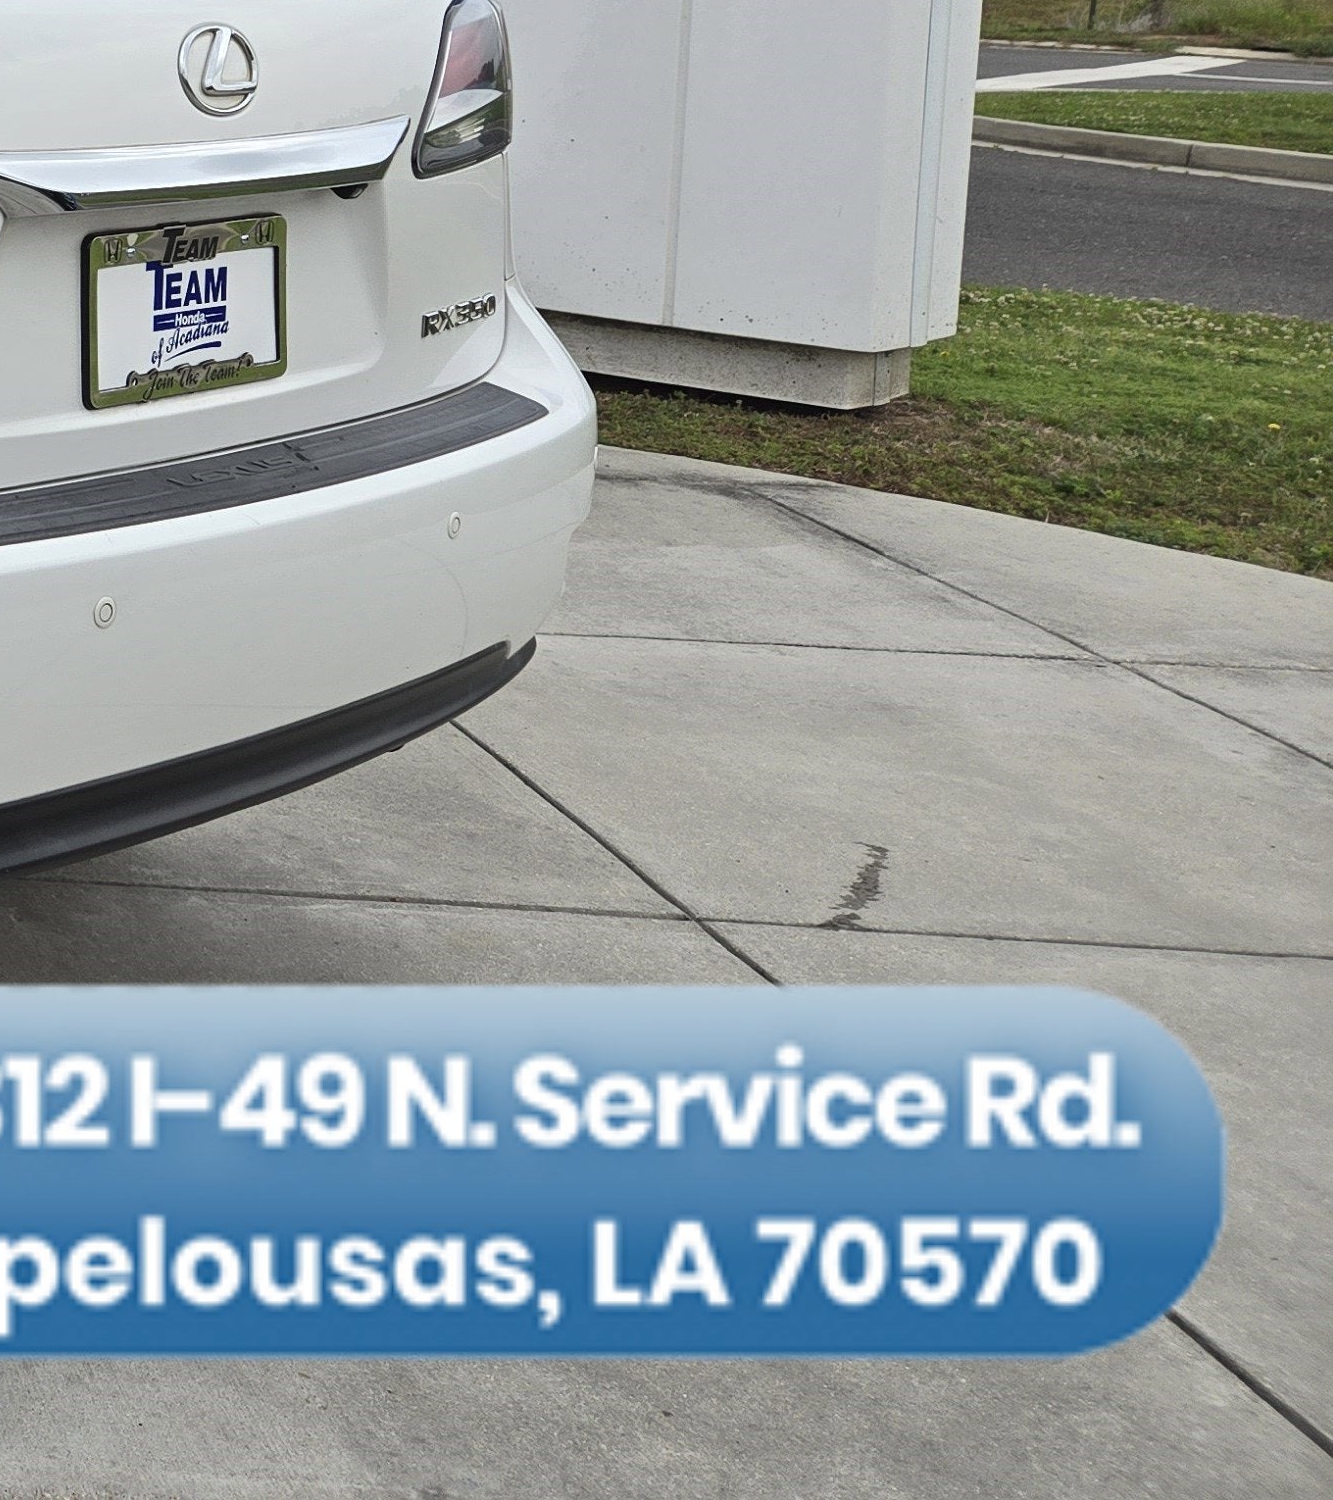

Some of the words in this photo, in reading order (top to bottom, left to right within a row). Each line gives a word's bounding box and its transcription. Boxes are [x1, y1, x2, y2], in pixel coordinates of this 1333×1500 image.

[162, 227, 219, 265] TEAM
[146, 261, 228, 311] TEAM
[174, 312, 205, 326] Honda
[151, 337, 164, 368] of
[166, 320, 229, 352] Acadiana
[142, 372, 174, 401] Join
[178, 365, 200, 388] The
